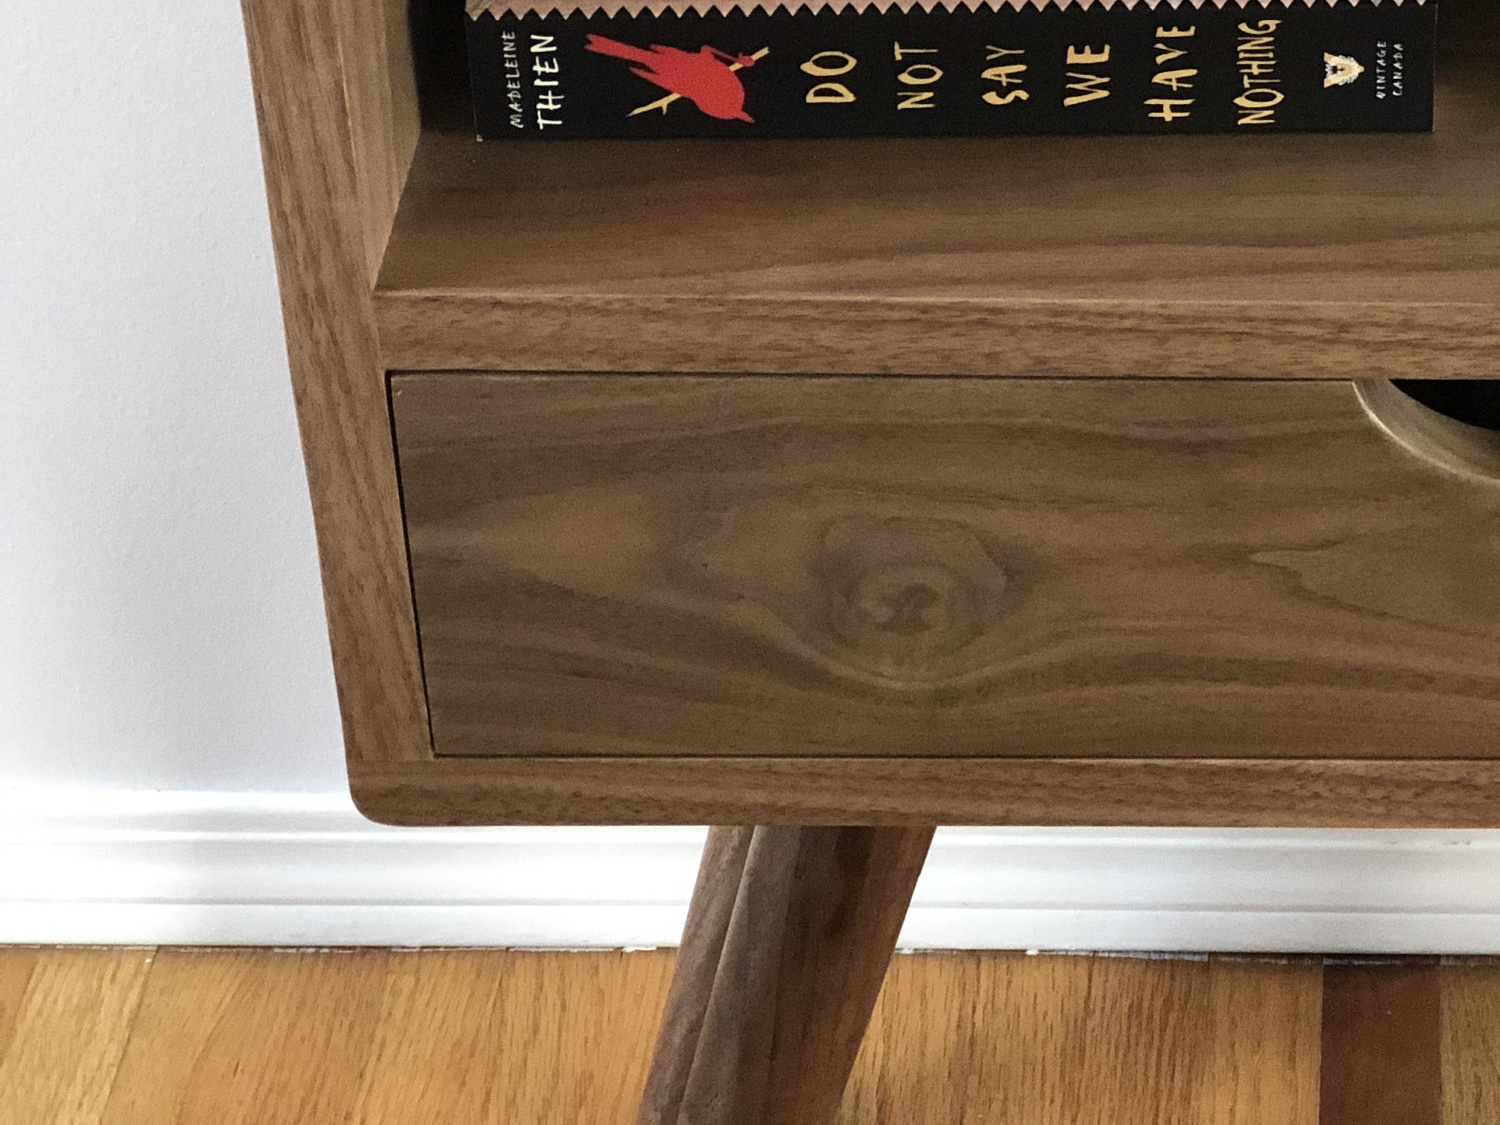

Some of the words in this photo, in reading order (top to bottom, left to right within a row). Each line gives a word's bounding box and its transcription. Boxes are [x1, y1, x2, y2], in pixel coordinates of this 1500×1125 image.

[501, 31, 524, 128] MADELEINE
[530, 34, 565, 130] THIEN
[800, 50, 858, 104] DO
[894, 41, 944, 111] NOT
[981, 45, 1030, 106] SAY
[1063, 44, 1111, 107] WE
[1144, 25, 1198, 122] HAVE
[1233, 19, 1285, 125] NOTHING
[1376, 40, 1386, 99] VINTAGE
[1392, 43, 1403, 96] CANADA
